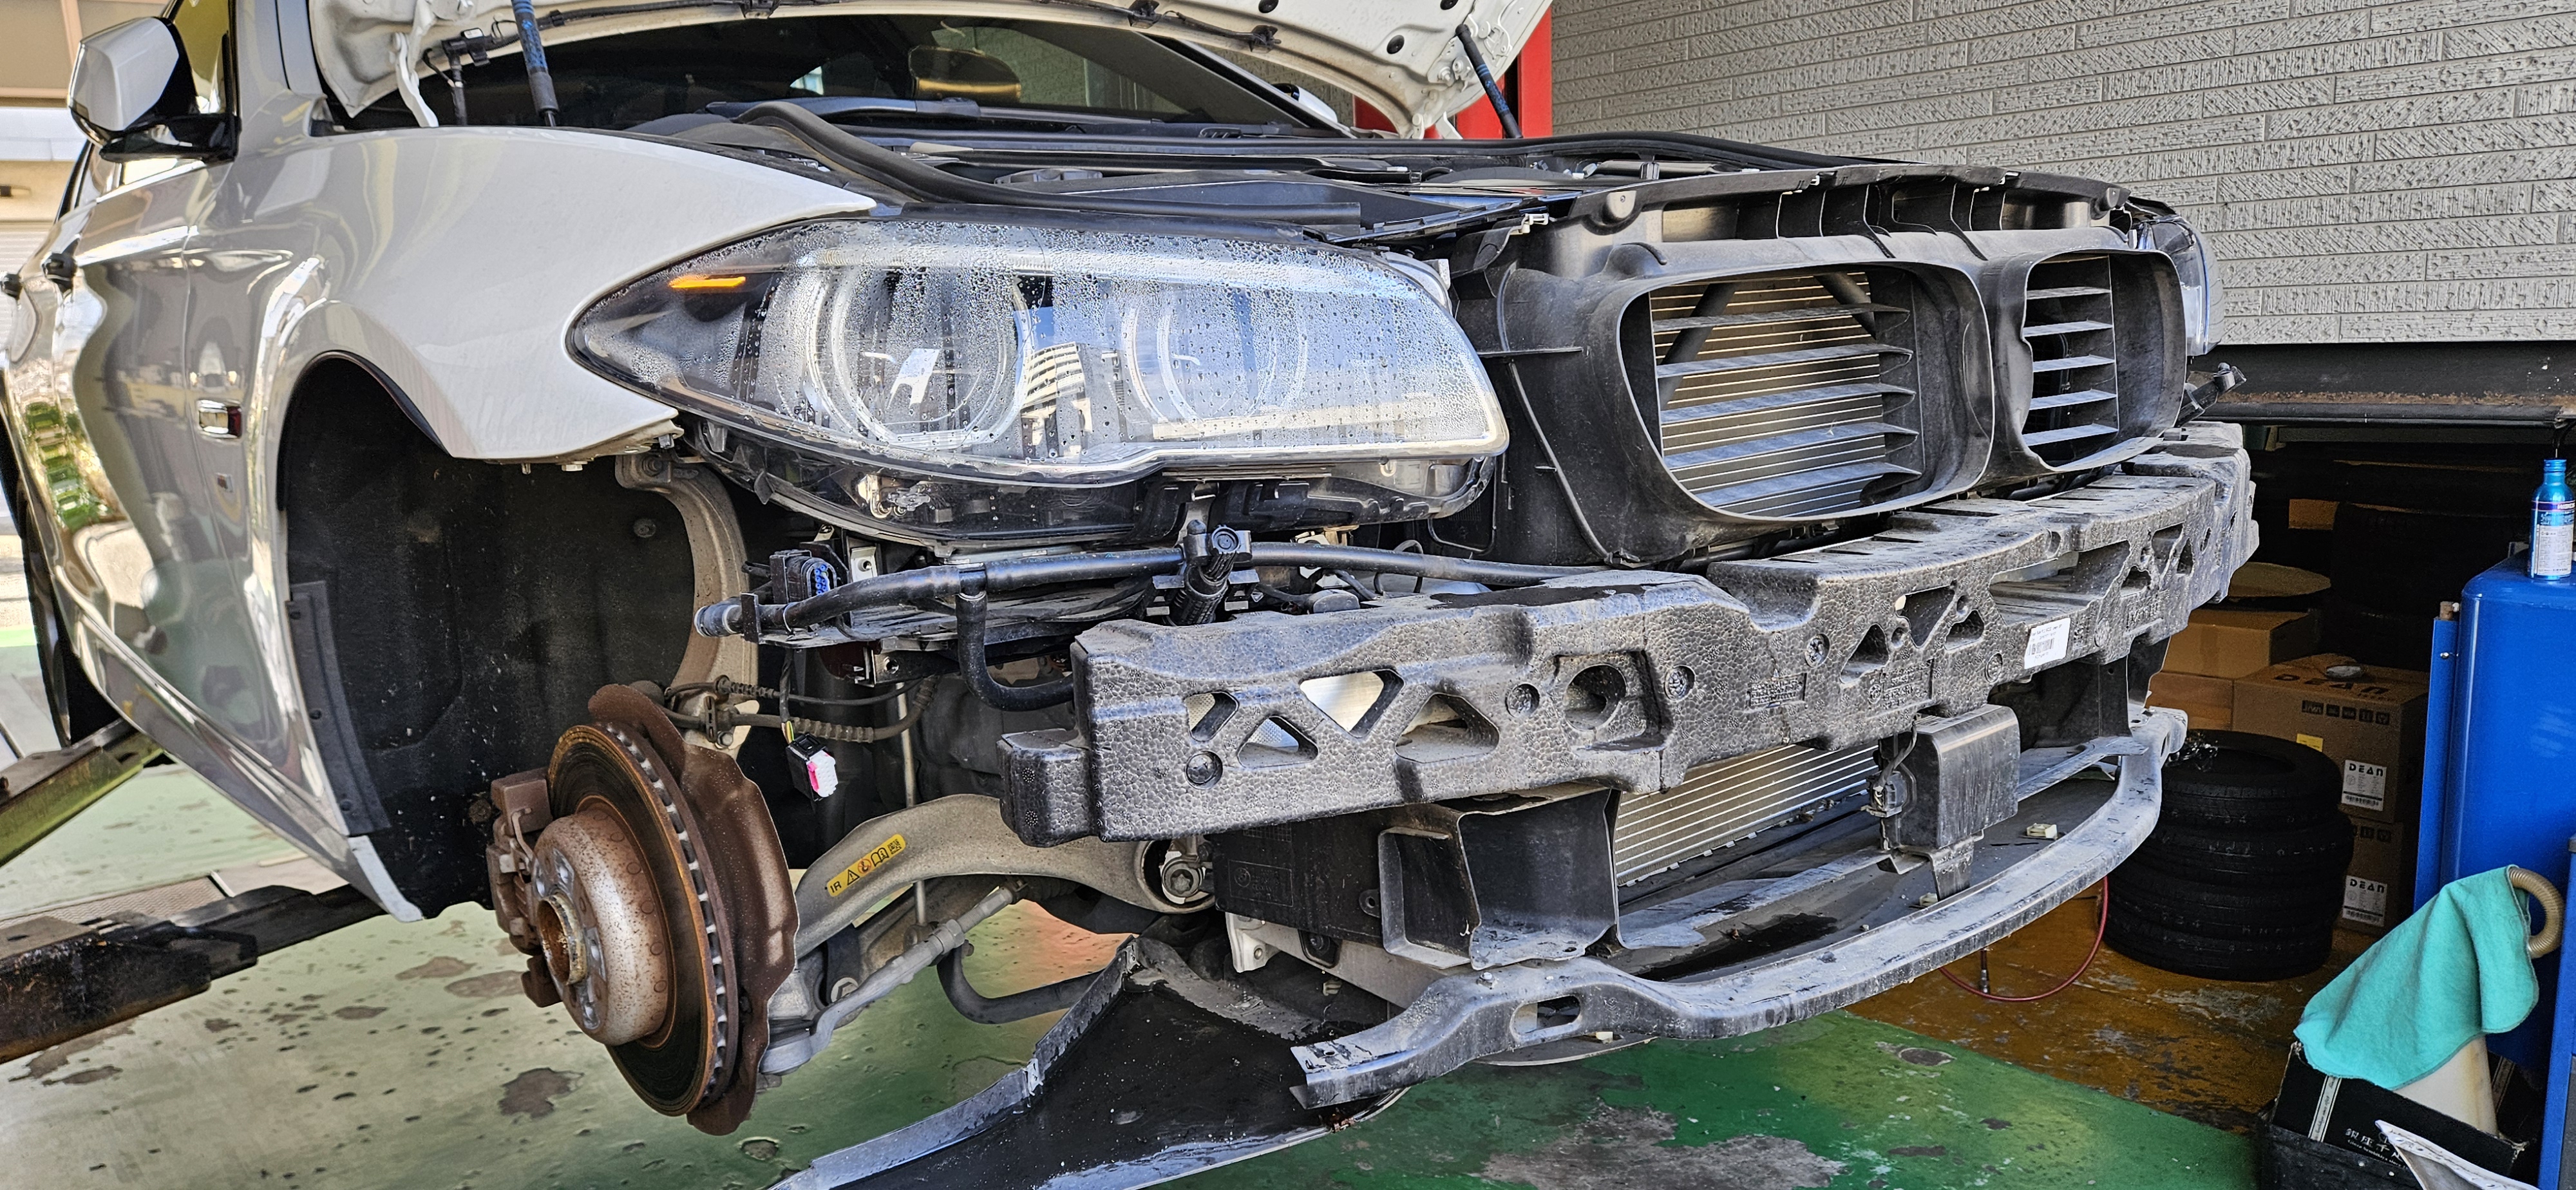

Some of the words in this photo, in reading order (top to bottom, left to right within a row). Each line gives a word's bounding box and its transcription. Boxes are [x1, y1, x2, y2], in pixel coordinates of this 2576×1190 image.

[2349, 763, 2383, 777] DEAN
[830, 881, 842, 893] IR
[2350, 878, 2385, 893] DEAN
